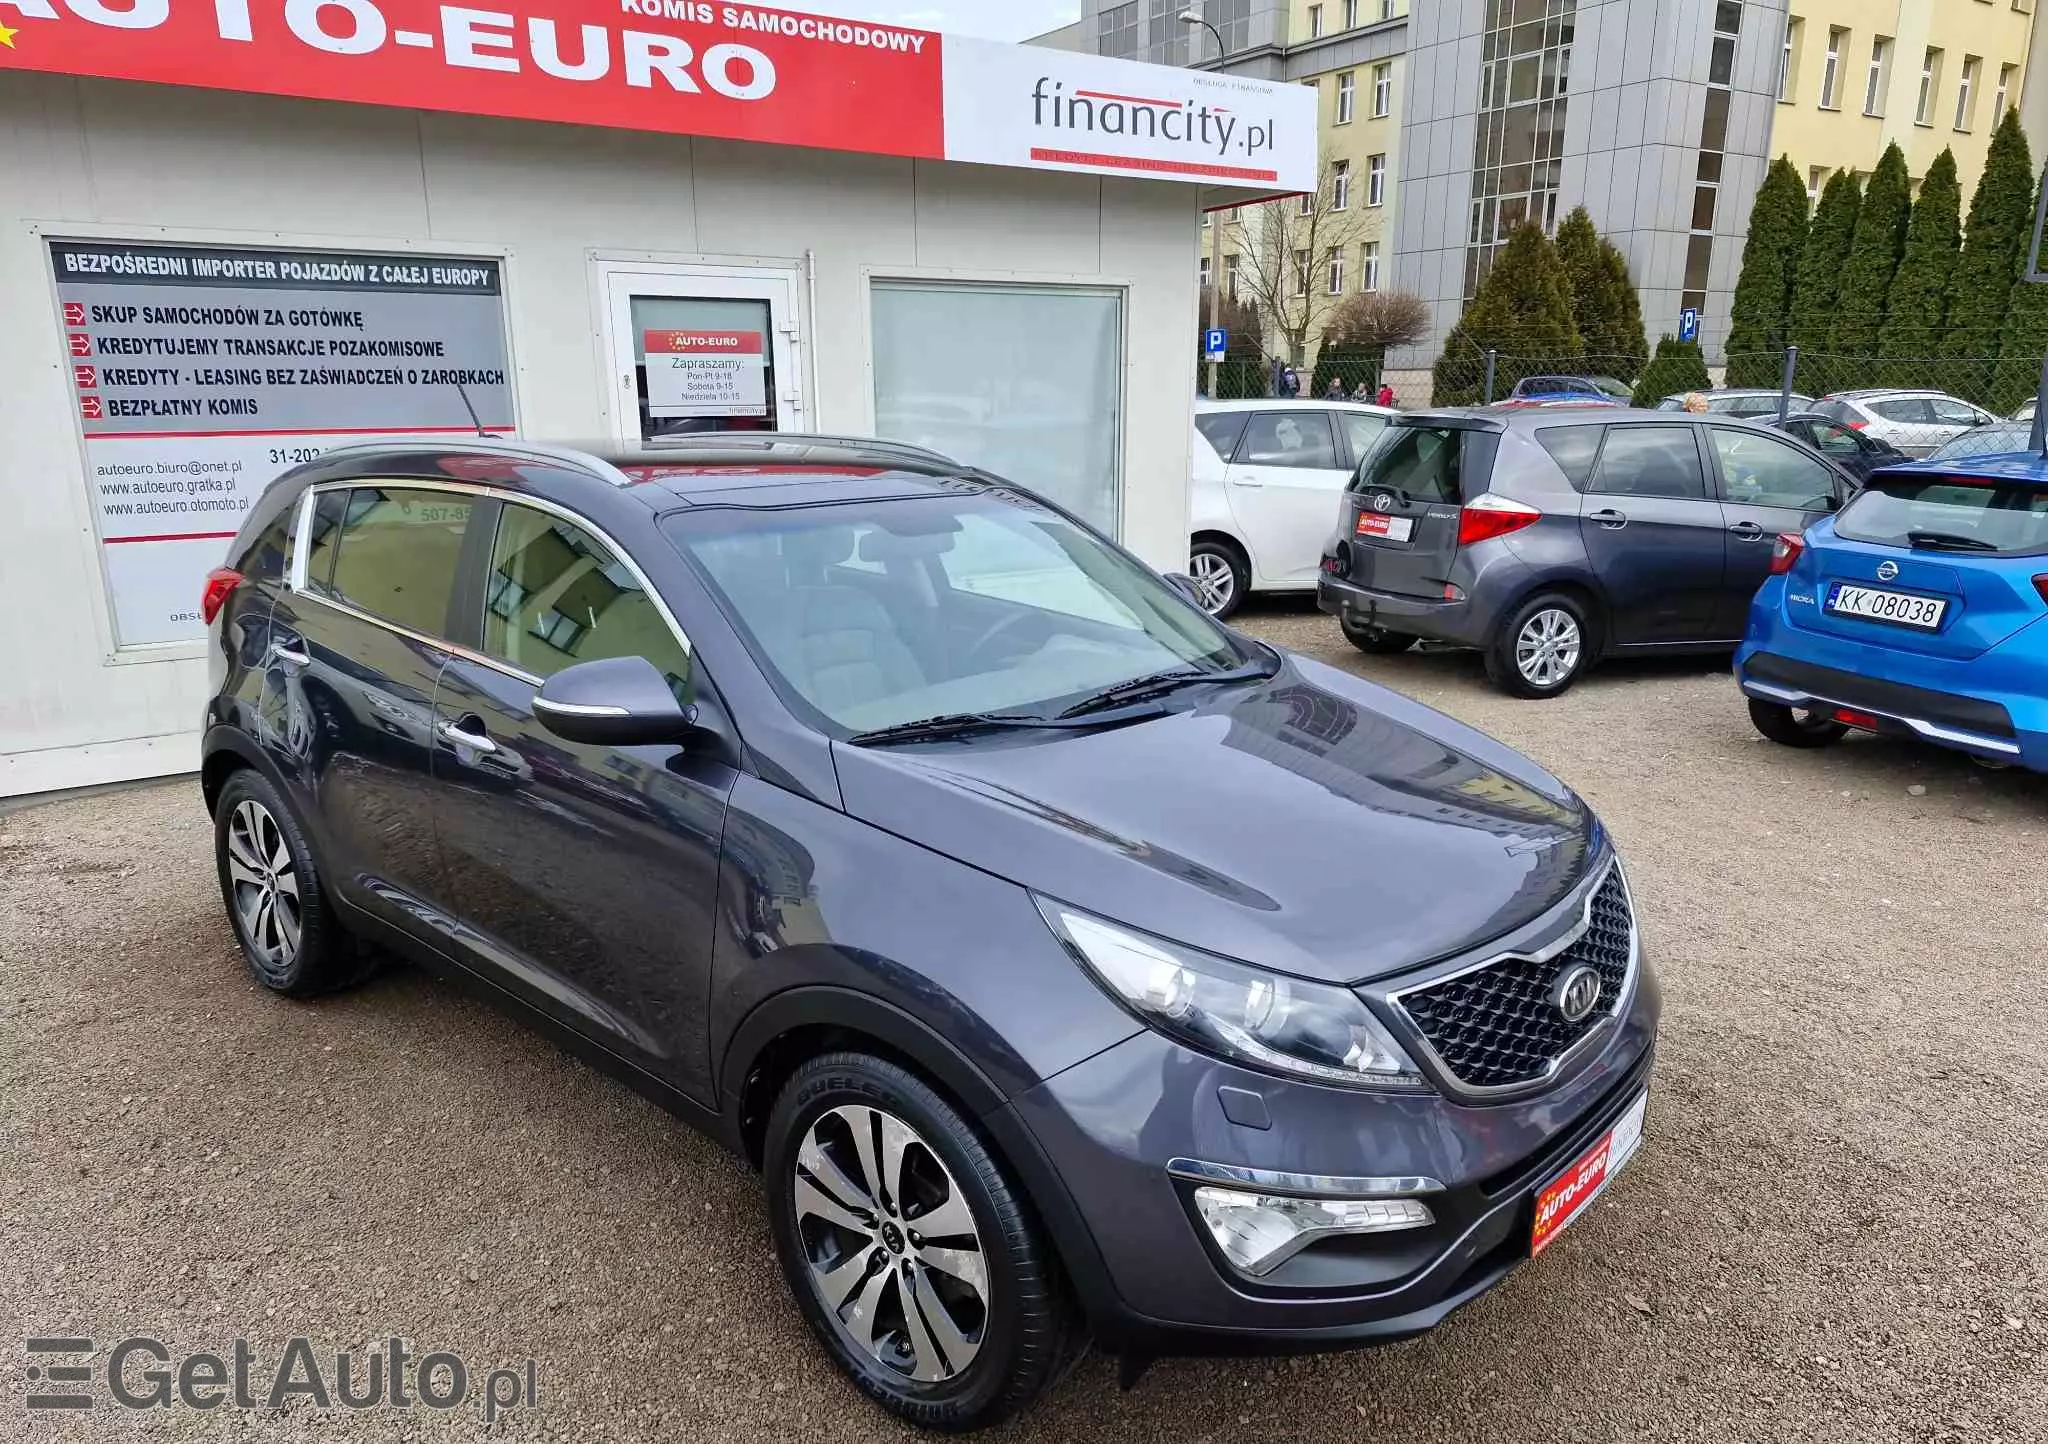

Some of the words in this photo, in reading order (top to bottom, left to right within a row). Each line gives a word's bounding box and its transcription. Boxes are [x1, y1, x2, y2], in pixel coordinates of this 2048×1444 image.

[622, 0, 714, 25] KOMIS
[722, 8, 926, 54] SAMOCHODOWY
[1032, 77, 1274, 156] financity.pl
[64, 251, 188, 276] BEZPOŚREDNI
[192, 258, 277, 279] IMPORTER
[280, 260, 365, 282] POJAZDÓW
[368, 265, 380, 283] Z
[382, 265, 429, 284] CAŁEJ
[432, 267, 489, 286] EUROPY
[91, 305, 138, 324] SKUP
[142, 304, 259, 325] SAMOCHODÓW
[263, 309, 285, 326] ZA
[288, 307, 364, 332] GOTÓWKĘ
[1684, 312, 1693, 333] P
[97, 337, 219, 355] KREDYTUJEMY
[224, 339, 326, 356] TRANSAKCJE
[329, 341, 444, 357] POZAKOMISOWE
[675, 336, 738, 346] AUTO-EURO
[1210, 331, 1221, 350] P
[671, 357, 745, 370] Zapraszamy:
[102, 368, 179, 386] KREDYTY
[194, 369, 262, 385] LEASING
[266, 369, 296, 385] BEZ
[300, 365, 403, 385] ZAŚWIADCZEŃ
[407, 369, 418, 385] O
[421, 369, 504, 385] ZAROBKACH
[108, 399, 201, 417] BEZPŁATNY
[207, 398, 258, 415] KOMIS
[97, 460, 242, 476] autoeuro.biuro@onet.pl
[100, 477, 236, 495] www.autoeuro.gratka.pl
[104, 497, 249, 515] www.autoeuro.otomoto.pl
[1839, 589, 1867, 611] KK
[1871, 594, 1937, 623] 08038
[1541, 1151, 1607, 1226] AUTO-EURO
